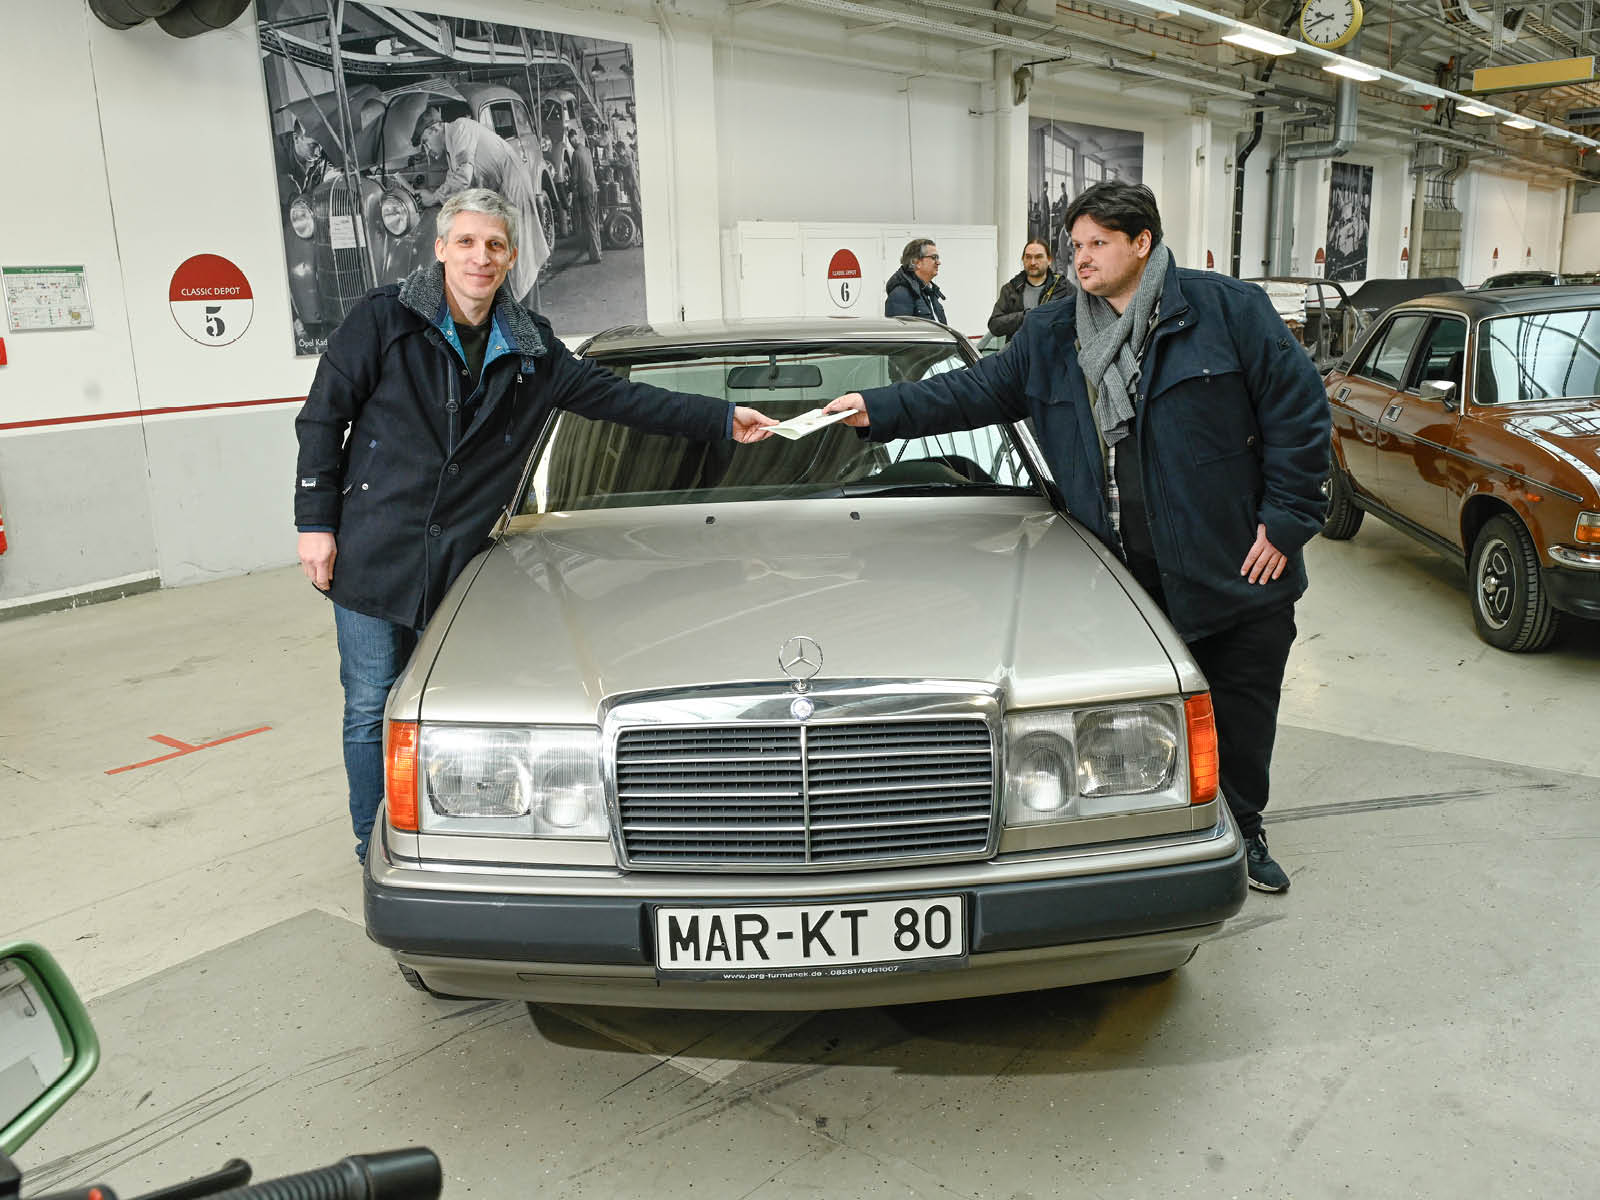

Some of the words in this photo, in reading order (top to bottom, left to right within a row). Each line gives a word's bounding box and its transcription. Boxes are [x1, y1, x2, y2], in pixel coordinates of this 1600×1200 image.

[181, 287, 212, 296] CLASSIC
[214, 286, 240, 295] DEPOT
[840, 282, 850, 302] 6
[205, 306, 225, 337] 5
[298, 338, 314, 349] Opel
[315, 338, 328, 346] Kad
[893, 904, 951, 952] 80
